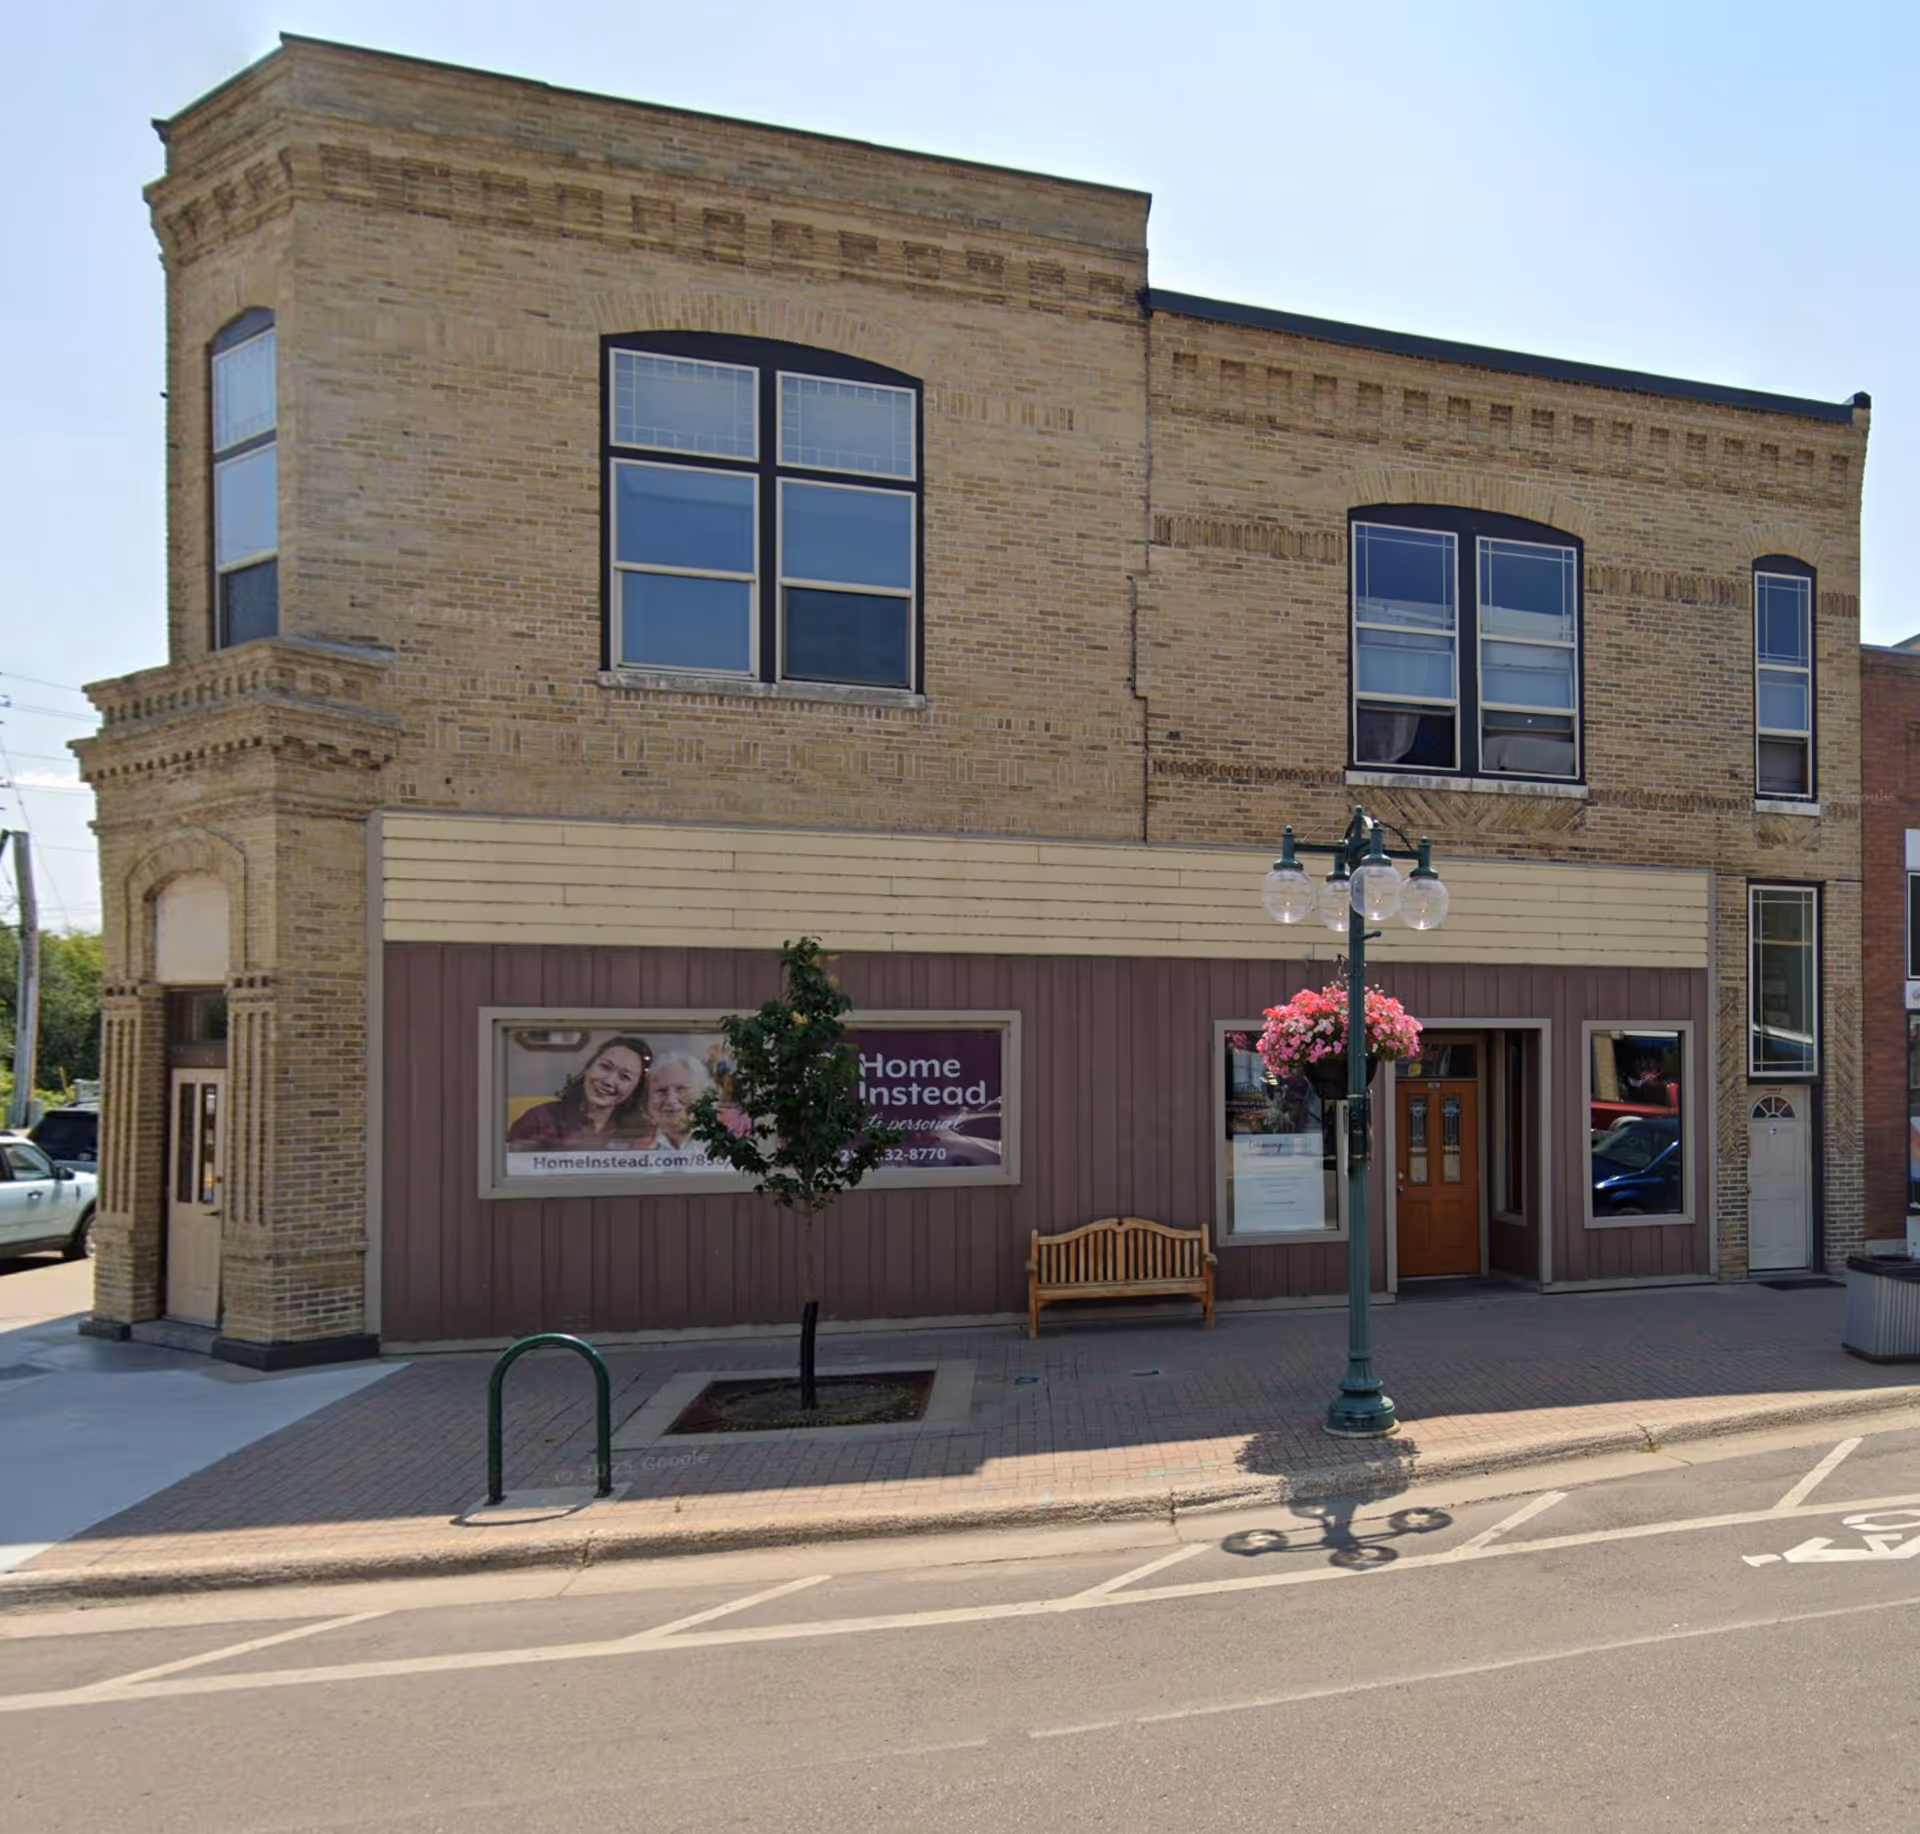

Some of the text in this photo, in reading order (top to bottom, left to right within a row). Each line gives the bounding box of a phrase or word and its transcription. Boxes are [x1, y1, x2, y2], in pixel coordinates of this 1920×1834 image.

[858, 1052, 961, 1079] Home
[858, 1080, 986, 1106] Instead
[887, 1112, 965, 1132] personal
